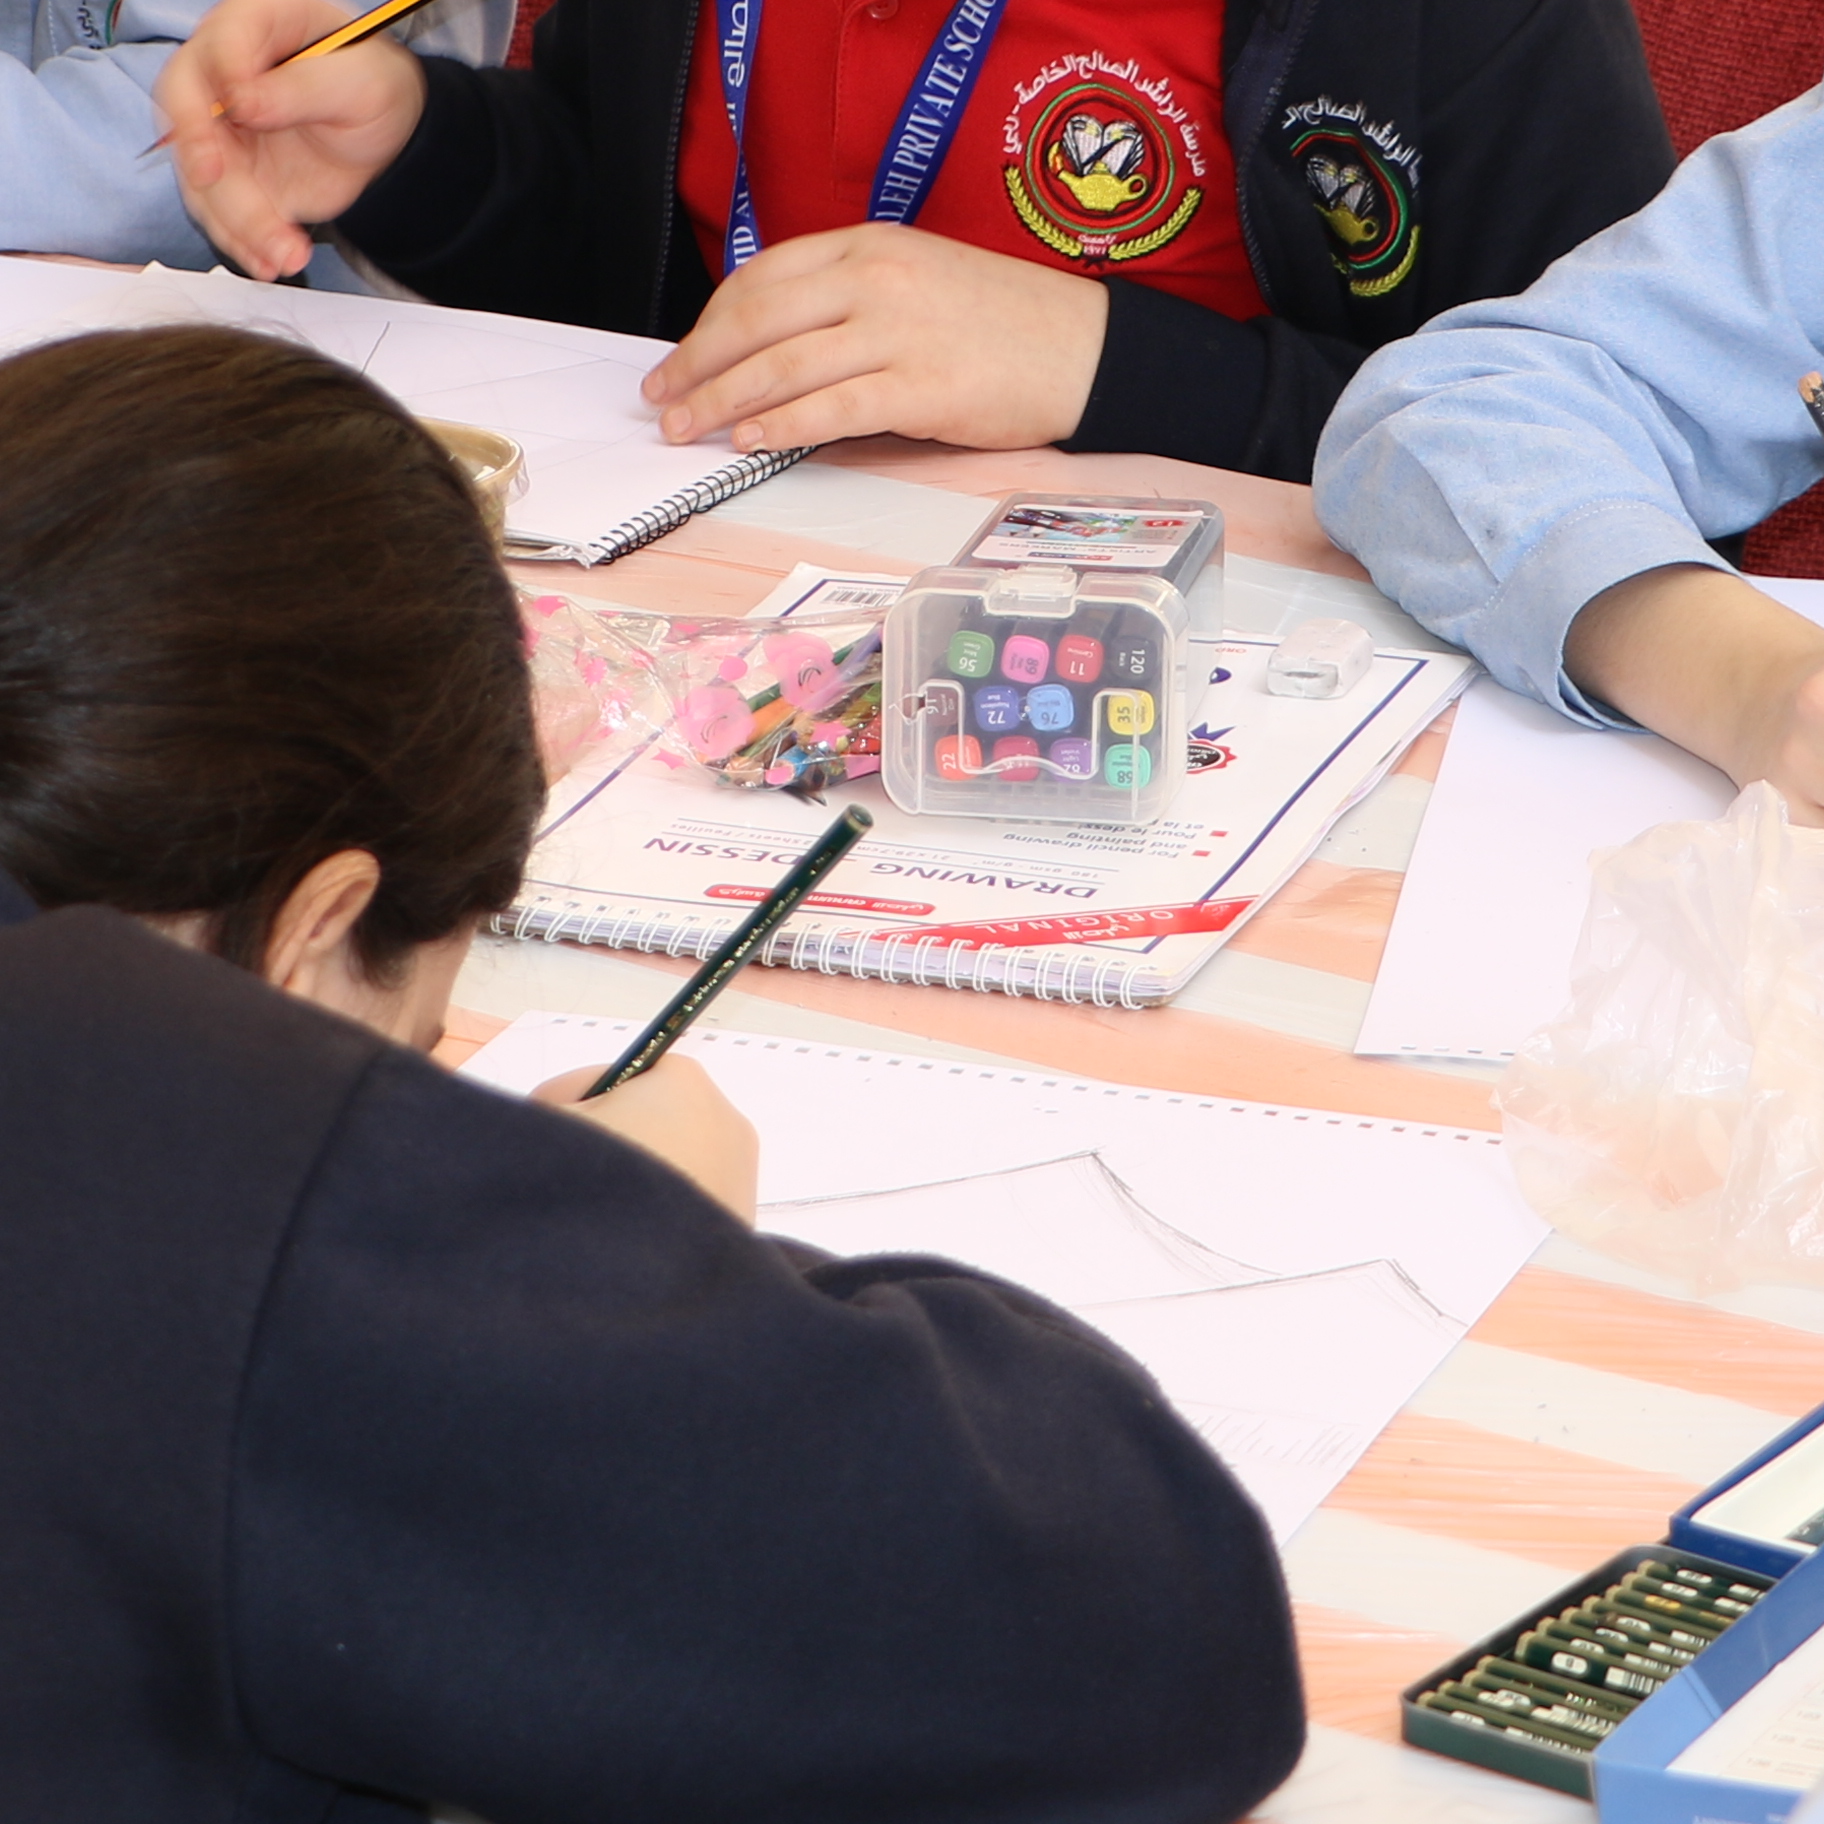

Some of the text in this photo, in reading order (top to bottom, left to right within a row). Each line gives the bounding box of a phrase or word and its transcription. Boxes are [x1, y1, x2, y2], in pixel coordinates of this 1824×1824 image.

[1014, 53, 1077, 104] الخاصة
[1076, 49, 1140, 84] الصالح
[892, 53, 967, 172] PRIVATE
[875, 170, 922, 225] LEH
[958, 657, 979, 673] 56
[1069, 661, 1085, 676] 11
[1130, 649, 1145, 674] 120
[987, 710, 1006, 725] 72
[1040, 710, 1059, 725] 76
[1117, 705, 1131, 724] 35
[942, 752, 957, 771] 22
[643, 837, 806, 866] DESSIN
[1002, 833, 1180, 860] For pencil drawing
[1065, 831, 1188, 850] and painting
[869, 861, 1100, 899] DRAWING
[975, 909, 1175, 935] ORIGINAL
